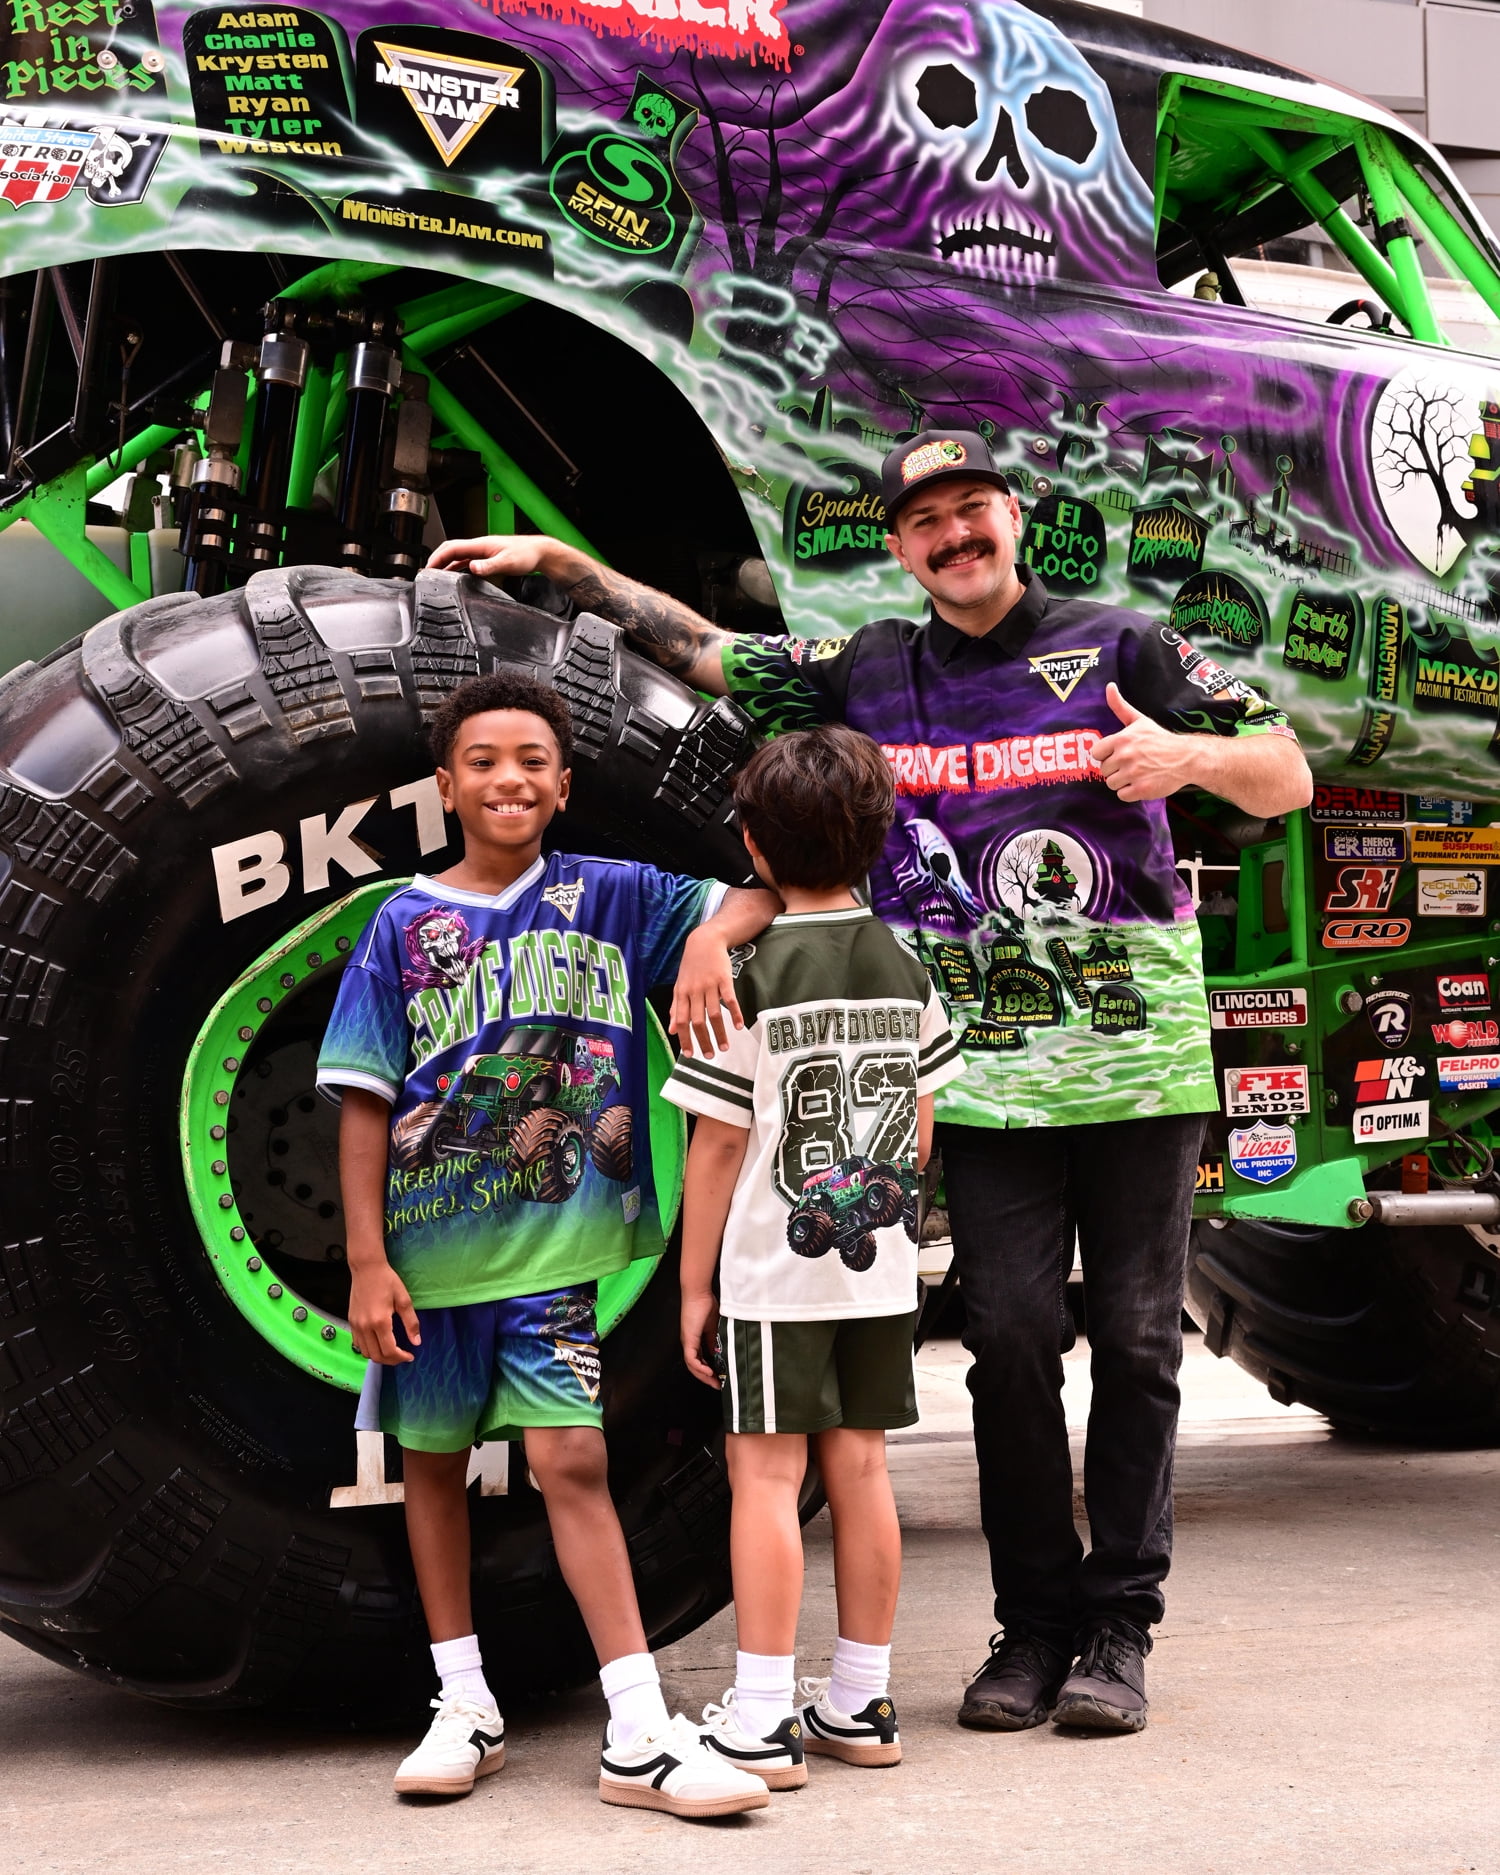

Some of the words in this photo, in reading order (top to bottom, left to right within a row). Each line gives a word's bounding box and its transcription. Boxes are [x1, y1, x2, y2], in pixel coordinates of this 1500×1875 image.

[10, 0, 124, 35] Rest
[217, 12, 300, 29] Adam
[50, 28, 96, 63] in
[204, 30, 316, 50] Charlie
[196, 52, 329, 75] Krysten
[1, 56, 156, 99] Pieces
[224, 74, 304, 91] Matt
[376, 62, 520, 110] MONSTER
[228, 95, 311, 116] Ryan
[417, 97, 480, 124] JAM
[225, 116, 322, 139] Tyler
[40, 131, 90, 146] States
[215, 138, 344, 158] Weston
[34, 145, 83, 163] ROD
[574, 181, 650, 237] SPIN
[906, 446, 939, 467] GRAVE
[906, 455, 943, 476] DIGGER
[802, 491, 886, 527] Sparkle
[795, 523, 889, 560] SMASH
[1132, 537, 1199, 569] DRAGON
[1294, 602, 1348, 641] Earth
[1287, 635, 1347, 668] Shaker
[1029, 657, 1100, 675] MONSTER
[1048, 669, 1080, 683] JAM
[1418, 657, 1499, 692] MAX-D
[1415, 681, 1452, 700] MAXIMUM
[1454, 686, 1499, 708] DESTRUCTION
[974, 731, 1100, 782] DIGGER
[1315, 787, 1401, 809] DERALE
[1316, 809, 1401, 818] PERFORMANCE
[1362, 837, 1394, 847] ENERGY
[1415, 830, 1474, 842] ENERGY
[212, 775, 448, 924] BKT
[1362, 847, 1397, 857] RELEASE
[1421, 882, 1476, 890] TECHLINE
[1327, 923, 1408, 939] CRD
[994, 945, 1022, 960] RIP
[508, 928, 634, 1036] DIGGER
[1438, 977, 1485, 997] Coan
[991, 992, 1054, 1014] 1982
[1099, 993, 1136, 1011] Earth
[1215, 993, 1290, 1010] LINCOLN
[1094, 1011, 1139, 1026] Shaker
[1233, 1011, 1298, 1025] WELDERS
[965, 1029, 1016, 1045] ZOMBIE
[1431, 1020, 1499, 1048] WORLD
[1237, 1071, 1303, 1092] FK
[1446, 1073, 1497, 1082] PERFORMANCE
[1458, 1081, 1488, 1090] GASKETS
[1248, 1091, 1305, 1102] ROD
[1232, 1102, 1305, 1115] ENDS
[771, 1050, 919, 1210] 87
[1376, 1112, 1420, 1131] OPTIMA
[1238, 1140, 1291, 1158] LUCAS
[1235, 1161, 1249, 1169] OIL
[1251, 1158, 1294, 1168] PRODUCTS
